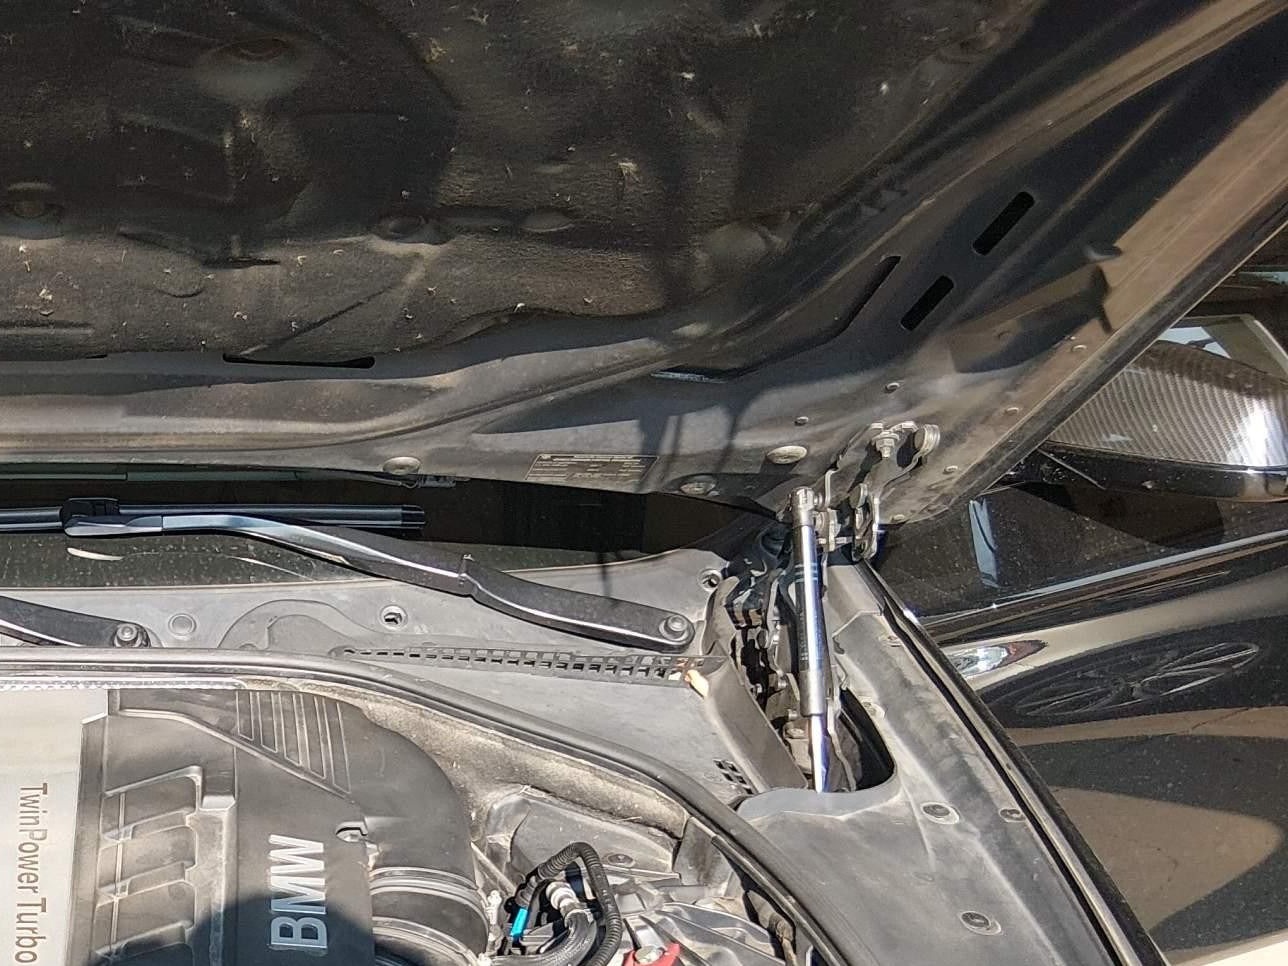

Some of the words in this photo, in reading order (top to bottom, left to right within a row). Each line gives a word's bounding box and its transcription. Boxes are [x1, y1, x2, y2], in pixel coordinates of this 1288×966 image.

[17, 782, 48, 894] TwinPower
[268, 834, 328, 949] BMW
[14, 897, 47, 964] Turbo
